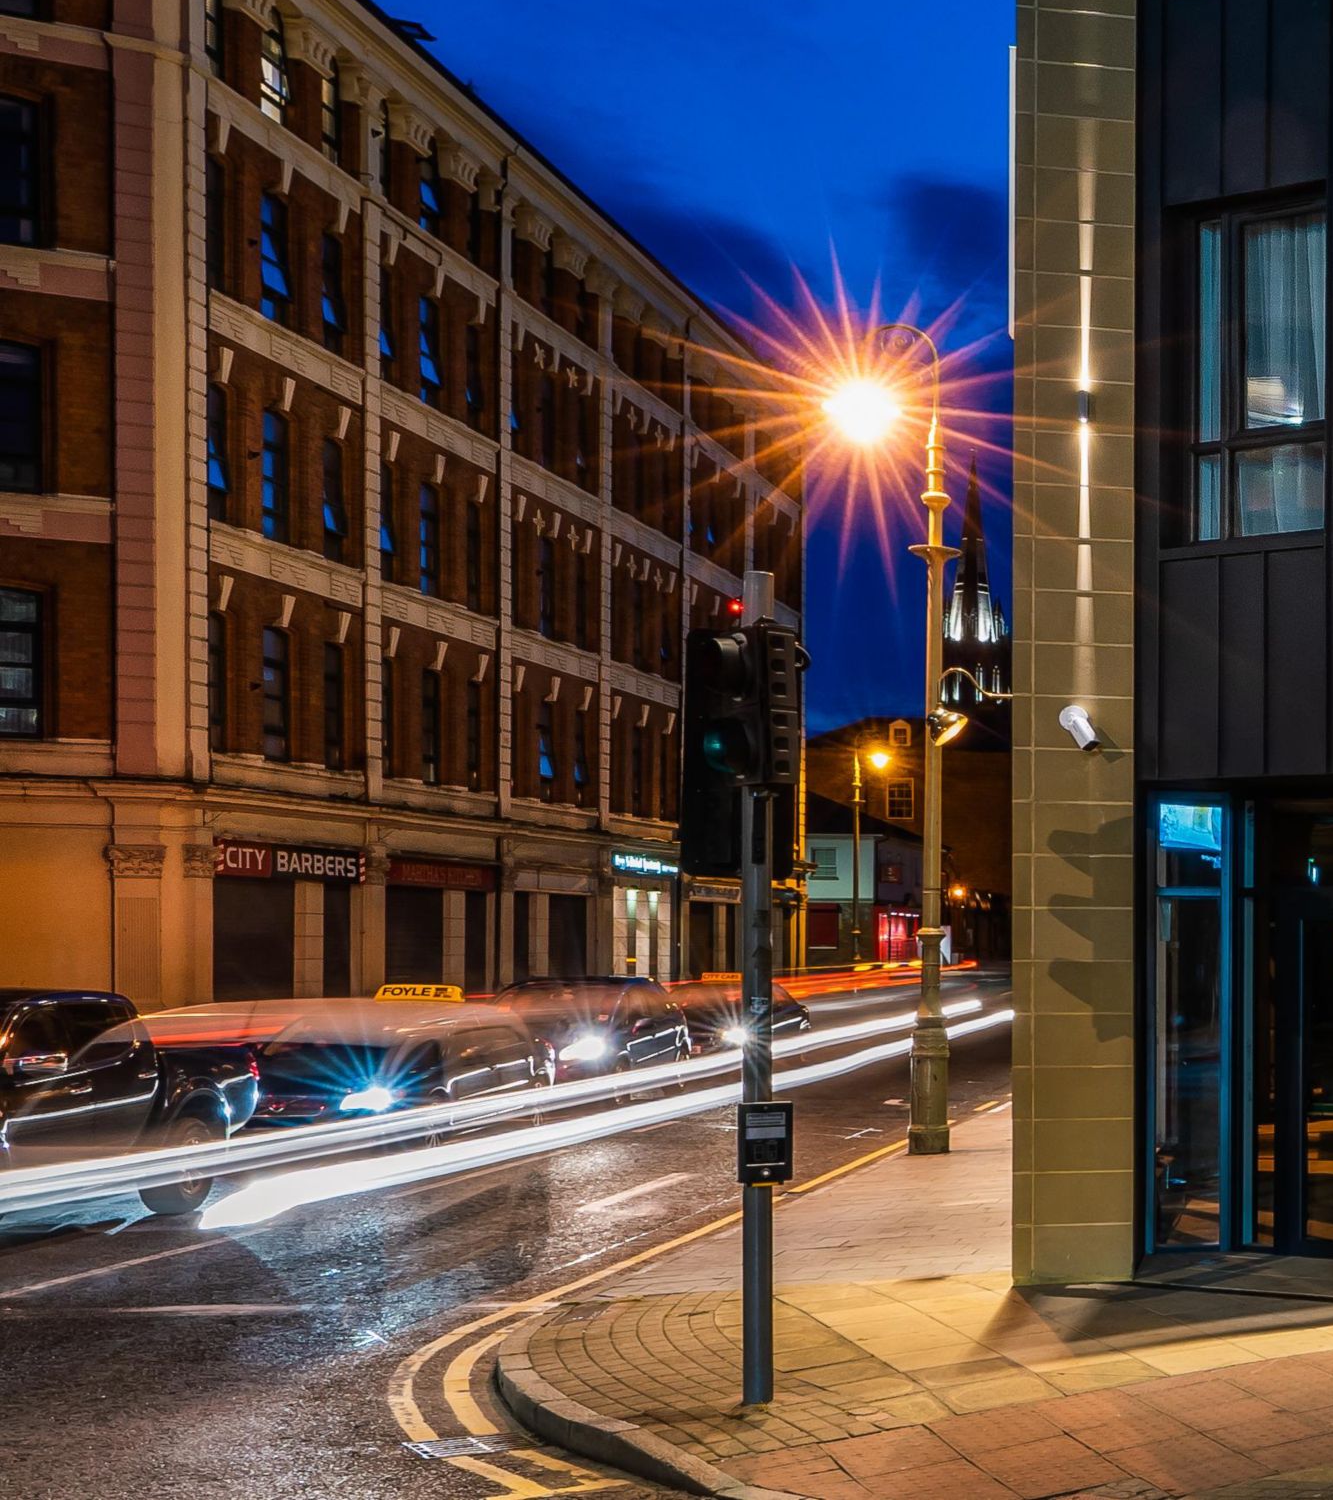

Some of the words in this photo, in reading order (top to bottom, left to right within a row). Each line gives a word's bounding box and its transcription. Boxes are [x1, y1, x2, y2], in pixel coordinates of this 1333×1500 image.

[225, 847, 266, 870] CITY
[276, 851, 357, 878] BARBERS
[382, 987, 432, 996] FOYLE
